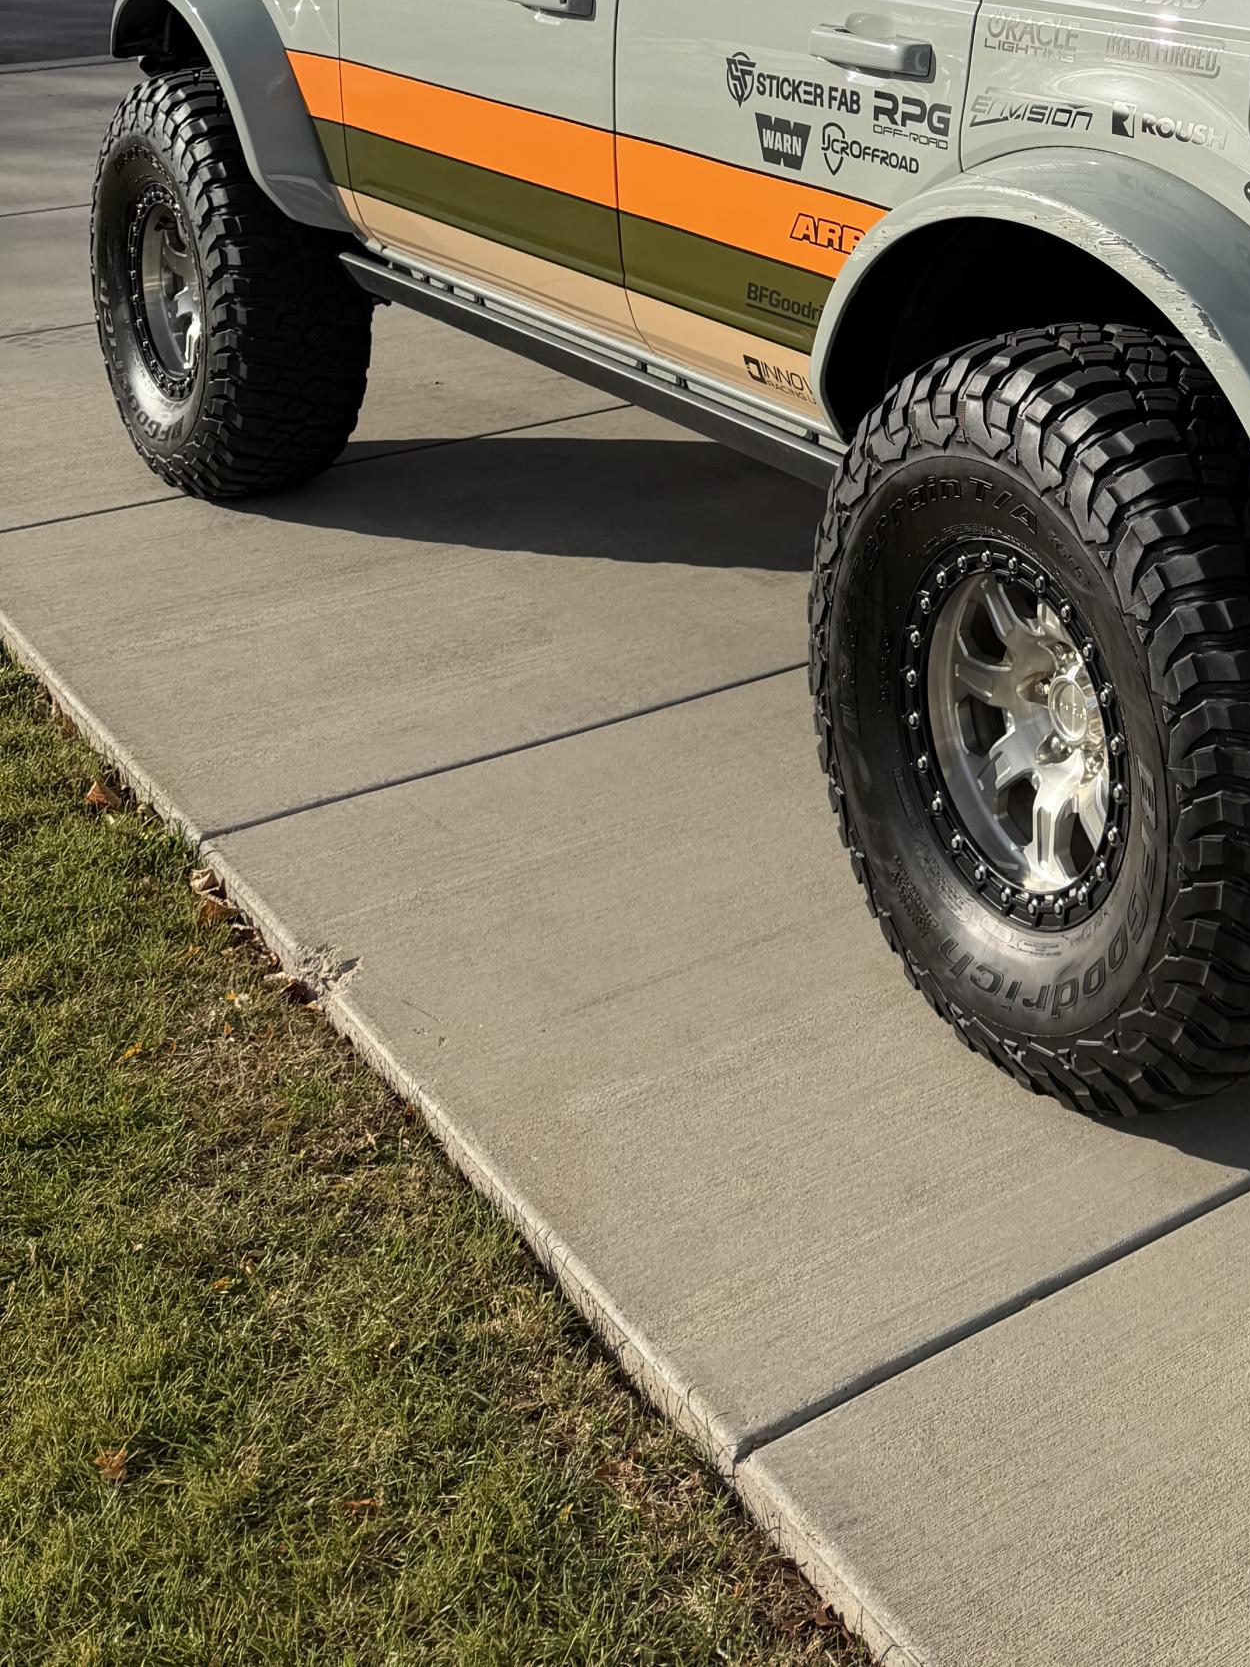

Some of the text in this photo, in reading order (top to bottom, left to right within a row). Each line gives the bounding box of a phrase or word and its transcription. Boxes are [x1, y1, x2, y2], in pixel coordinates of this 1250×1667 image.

[984, 37, 1077, 63] LIGHTING
[987, 13, 1082, 51] ORACLE
[755, 72, 824, 108] STICKER
[828, 85, 861, 115] FAB
[872, 90, 952, 138] RPG
[1141, 111, 1228, 151] ROUSH
[761, 127, 803, 158] WARN
[872, 123, 949, 150] OFF-ROAD
[937, 755, 1157, 1019] BFGoodrich
